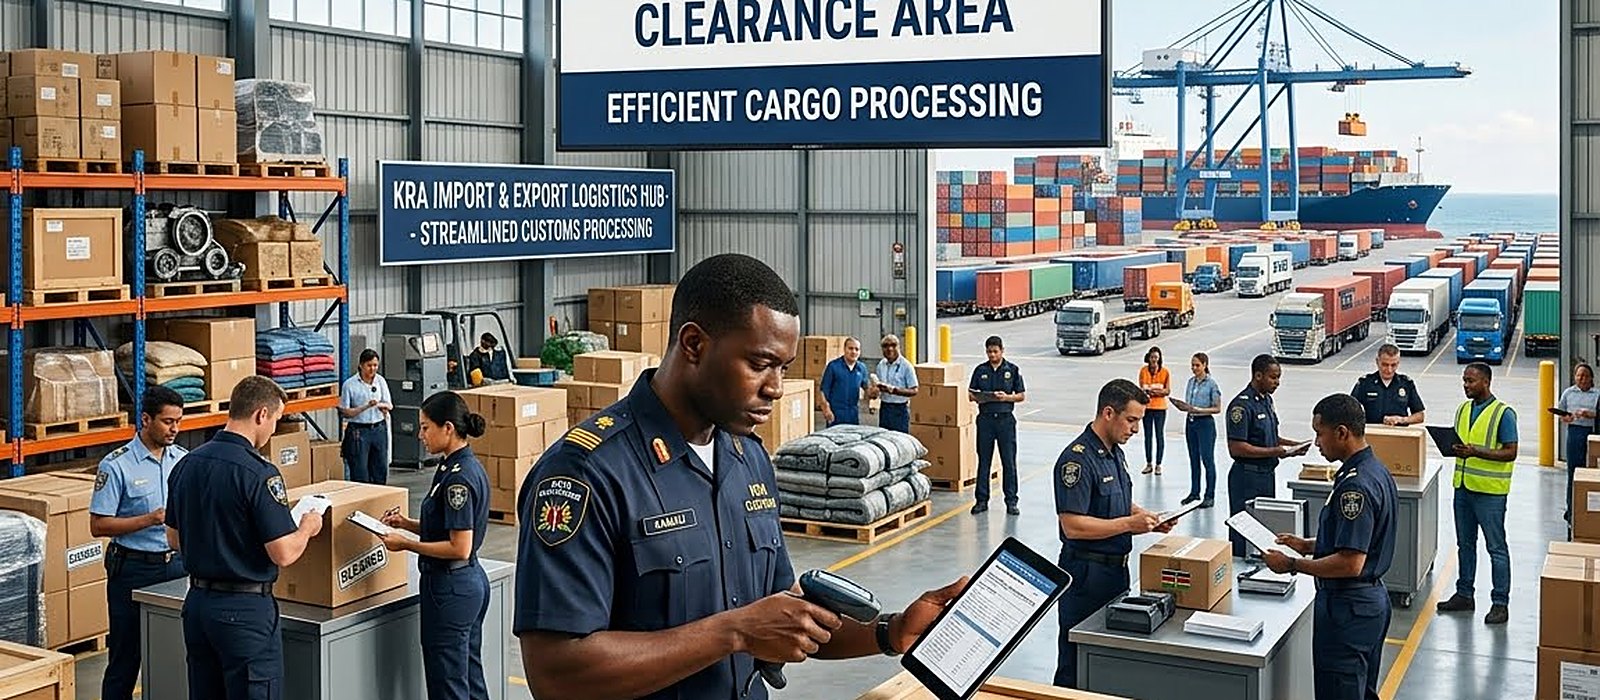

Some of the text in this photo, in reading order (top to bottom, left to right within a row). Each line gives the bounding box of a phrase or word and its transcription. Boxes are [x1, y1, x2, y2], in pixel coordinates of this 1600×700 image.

[635, 0, 1014, 47] CLEARANCE AREA
[607, 82, 1042, 124] EFFICIENT CARGO PROCESSING
[393, 180, 429, 210] KRA
[433, 181, 495, 210] IMPORT
[499, 182, 509, 208] &
[513, 182, 568, 208] EXPORT
[571, 184, 637, 208] LOGISTICS
[420, 219, 517, 246] STREAMLINED
[521, 218, 580, 242] CUSTOMS
[583, 216, 653, 240] PROCESSING
